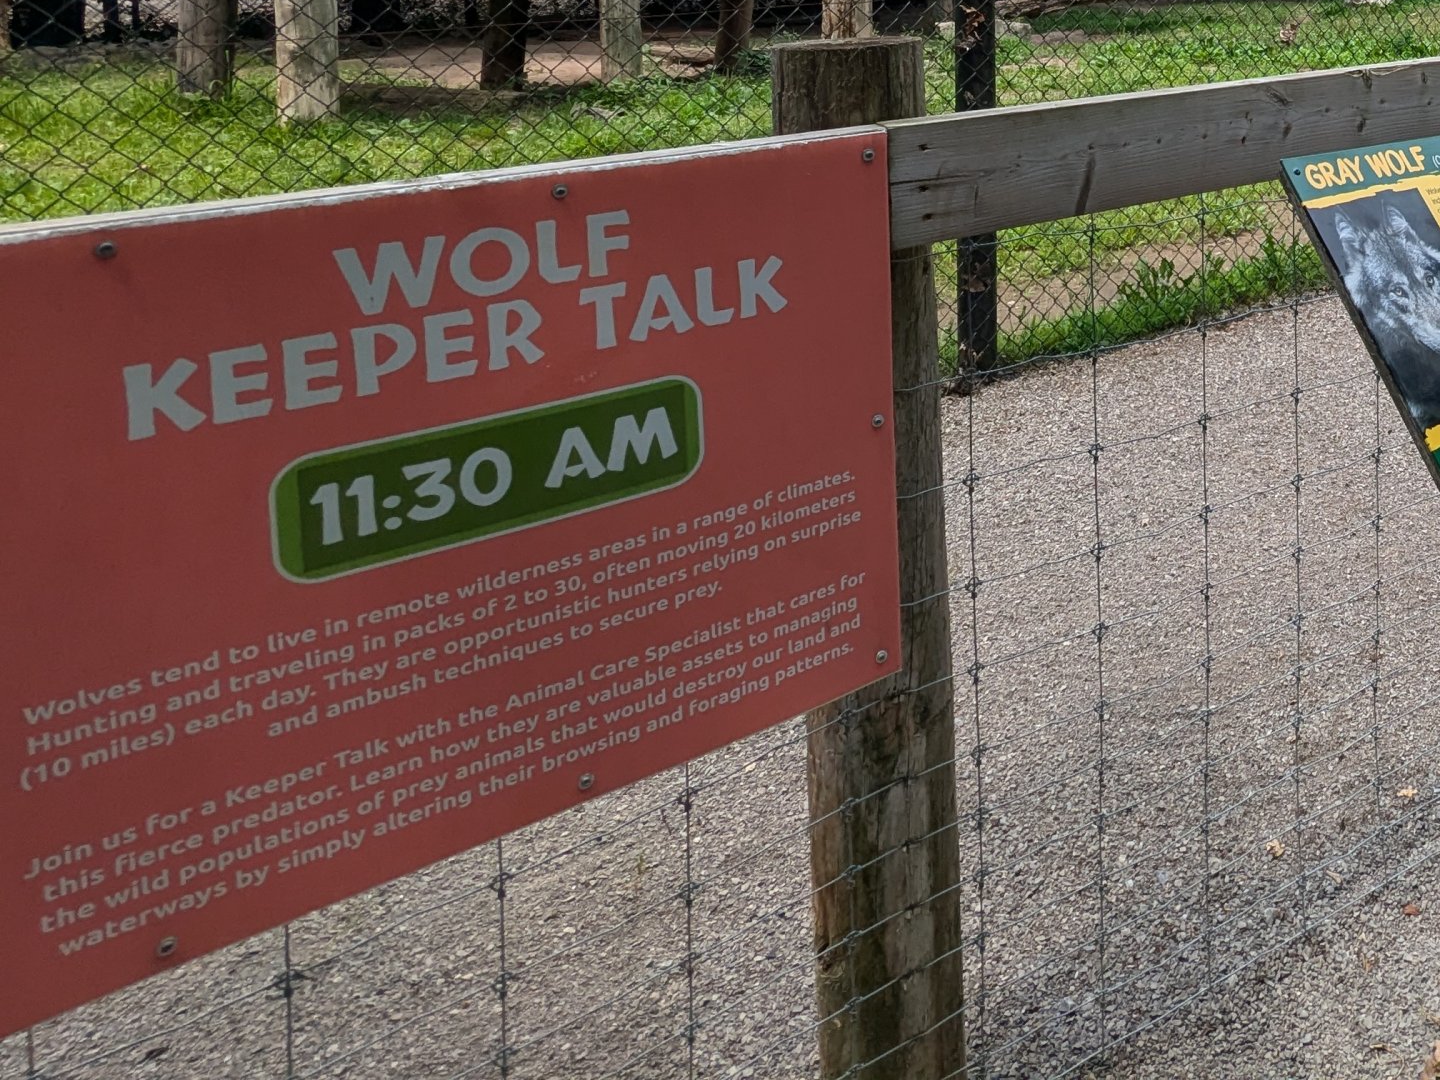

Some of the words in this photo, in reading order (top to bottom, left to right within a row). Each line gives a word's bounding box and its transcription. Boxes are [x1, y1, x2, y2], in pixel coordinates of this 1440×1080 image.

[333, 210, 631, 315] WOLF
[1304, 155, 1364, 190] GRAY
[1364, 145, 1425, 179] WOLF
[123, 299, 545, 441] KEEPER
[578, 255, 788, 350] TALK
[310, 446, 512, 545] 11:30
[545, 407, 678, 489] AM
[20, 757, 71, 791] (10
[81, 722, 174, 768] miles)
[184, 699, 252, 734] each
[261, 684, 316, 710] day.
[322, 660, 388, 690] They
[395, 647, 436, 669] are
[443, 595, 601, 654] opportunistic
[607, 568, 687, 604] hunters
[693, 544, 758, 576] relying
[763, 535, 786, 551] on
[790, 510, 861, 543] surprise
[22, 678, 142, 724] Wolves
[151, 649, 219, 687] tend
[228, 644, 259, 664] to
[267, 628, 316, 652] live
[324, 618, 348, 637] in
[356, 591, 449, 627] remote
[456, 553, 582, 598] wilderness
[588, 533, 646, 560] areas
[651, 526, 670, 542] in
[676, 521, 687, 534] a
[693, 503, 748, 529] range
[752, 490, 772, 510] of
[777, 470, 855, 502] climates.
[23, 843, 92, 879] Join
[102, 826, 137, 850] us
[146, 807, 192, 835] for
[200, 800, 216, 815] a
[225, 761, 326, 807] Keeper
[332, 738, 388, 768] Talk
[395, 717, 451, 747] with
[457, 704, 498, 727] the
[505, 669, 584, 711] Animal
[589, 655, 639, 680] Care
[644, 616, 741, 662] Specialist
[746, 600, 785, 625] that
[789, 583, 835, 608] cares
[840, 572, 865, 590] for
[27, 703, 156, 755] Hunting
[166, 678, 220, 711] and
[229, 644, 354, 692] traveling
[362, 634, 385, 652] in
[394, 612, 464, 647] packs
[471, 597, 497, 620] of
[503, 594, 517, 611] 2
[524, 588, 548, 604] to
[554, 575, 586, 596] 30,
[592, 556, 650, 583] often
[656, 531, 728, 564] moving
[733, 520, 755, 539] 20
[760, 490, 855, 530] kilometers
[267, 704, 317, 736] and
[325, 673, 426, 717] ambush
[433, 632, 563, 683] techniques
[569, 623, 593, 639] to
[599, 598, 668, 630] secure
[674, 580, 722, 609] prey.
[40, 902, 95, 932] the
[104, 868, 169, 907] wild
[179, 807, 349, 885] populations
[356, 789, 384, 815] of
[392, 772, 448, 807] prey
[455, 736, 544, 779] animals
[551, 716, 598, 743] that
[602, 687, 666, 724] would
[672, 661, 747, 698] destroy
[751, 647, 783, 668] our
[787, 626, 825, 654] land
[830, 612, 860, 637] and
[43, 868, 104, 902] this
[114, 833, 202, 876] fierce
[212, 784, 342, 844] predator.
[350, 756, 422, 791] Learn
[429, 735, 480, 763] how
[486, 714, 539, 742] they
[545, 699, 581, 721] are
[586, 665, 676, 705] valuable
[682, 640, 743, 672] assets
[748, 631, 768, 647] to
[773, 596, 857, 638] managing
[58, 881, 227, 956] waterways
[235, 865, 269, 888] by
[277, 828, 365, 873] simply
[372, 789, 471, 836] altering
[478, 764, 535, 796] their
[541, 725, 640, 772] browsing
[646, 704, 683, 732] and
[688, 675, 769, 716] foraging
[774, 642, 853, 685] patterns.
